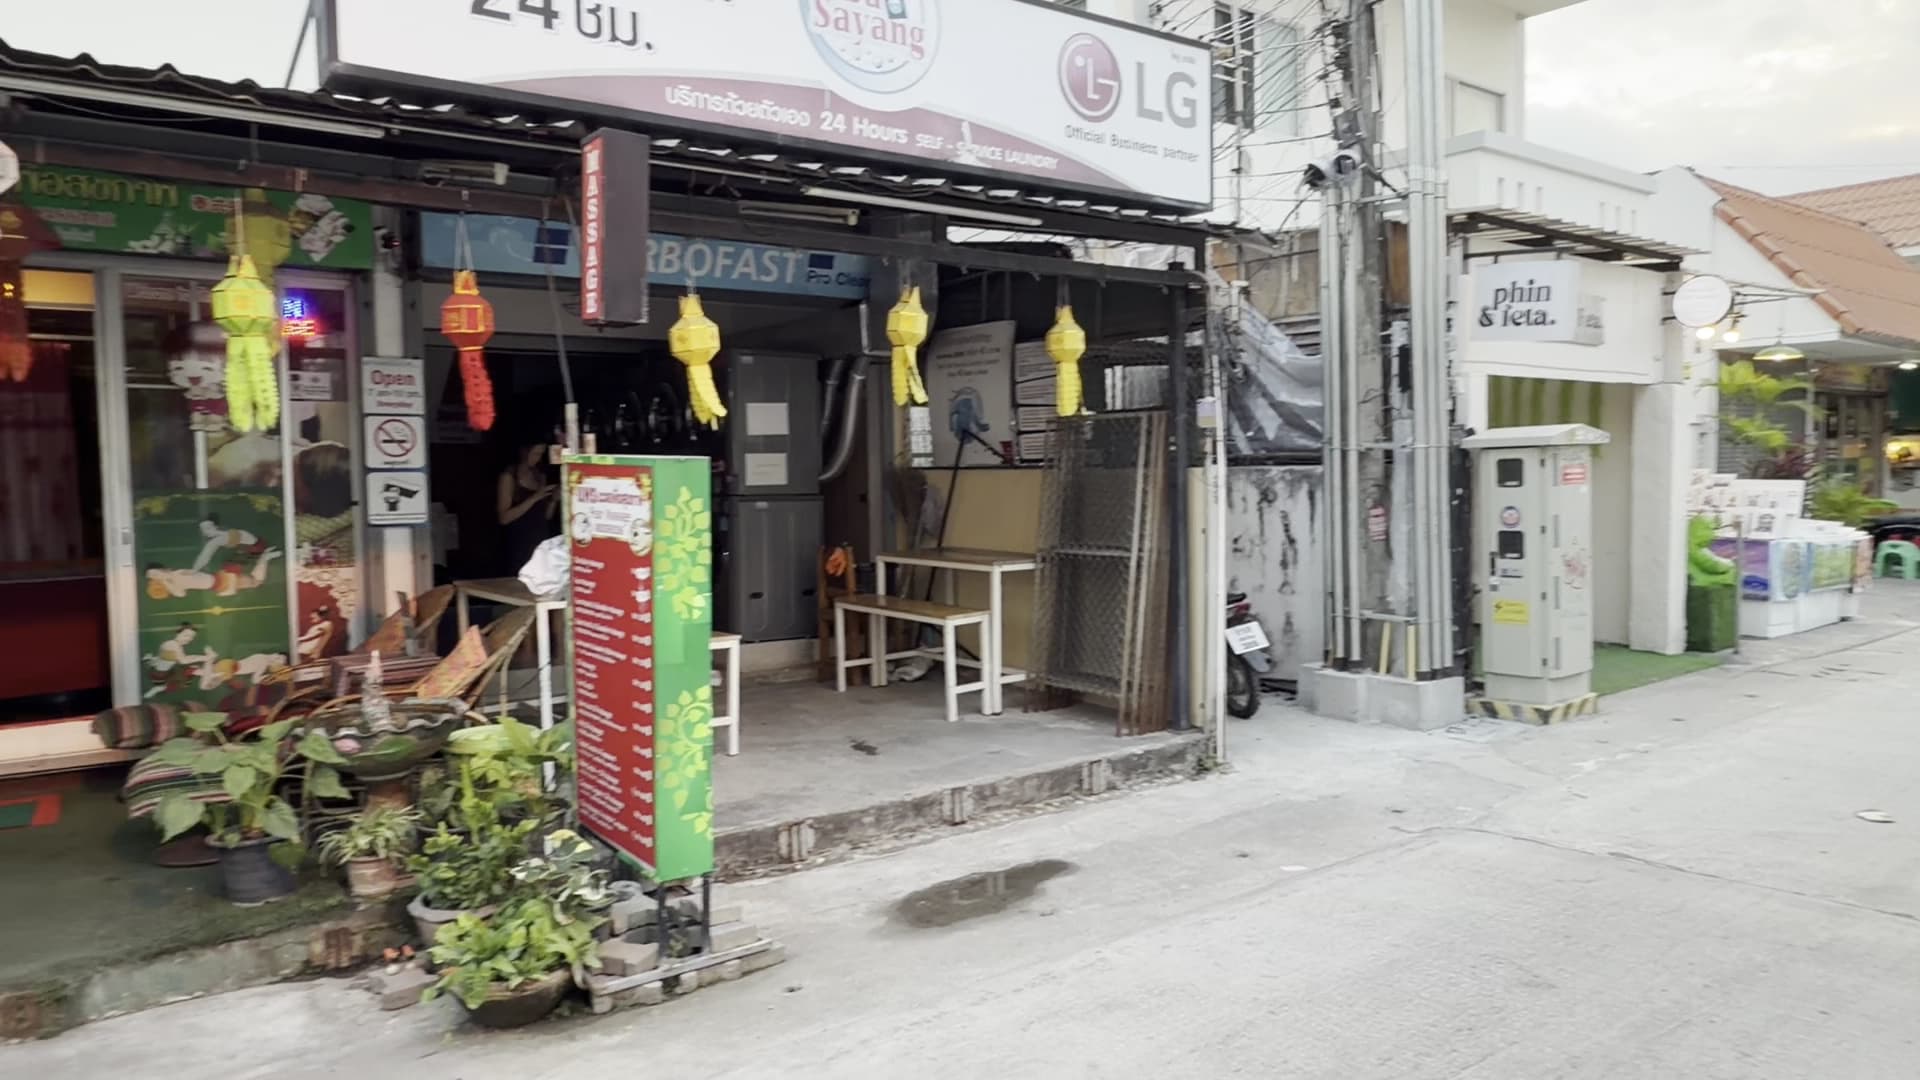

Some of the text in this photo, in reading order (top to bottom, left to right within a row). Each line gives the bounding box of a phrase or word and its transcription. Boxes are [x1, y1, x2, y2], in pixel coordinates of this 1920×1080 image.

[815, 0, 926, 60] Sayang
[1136, 61, 1197, 128] LG
[819, 111, 847, 133] 24
[1064, 124, 1106, 144] Official
[1111, 133, 1159, 155] Business
[585, 147, 600, 314] MASSAGE
[1493, 278, 1551, 310] phin
[1478, 305, 1494, 327] &
[371, 370, 416, 387] Open
